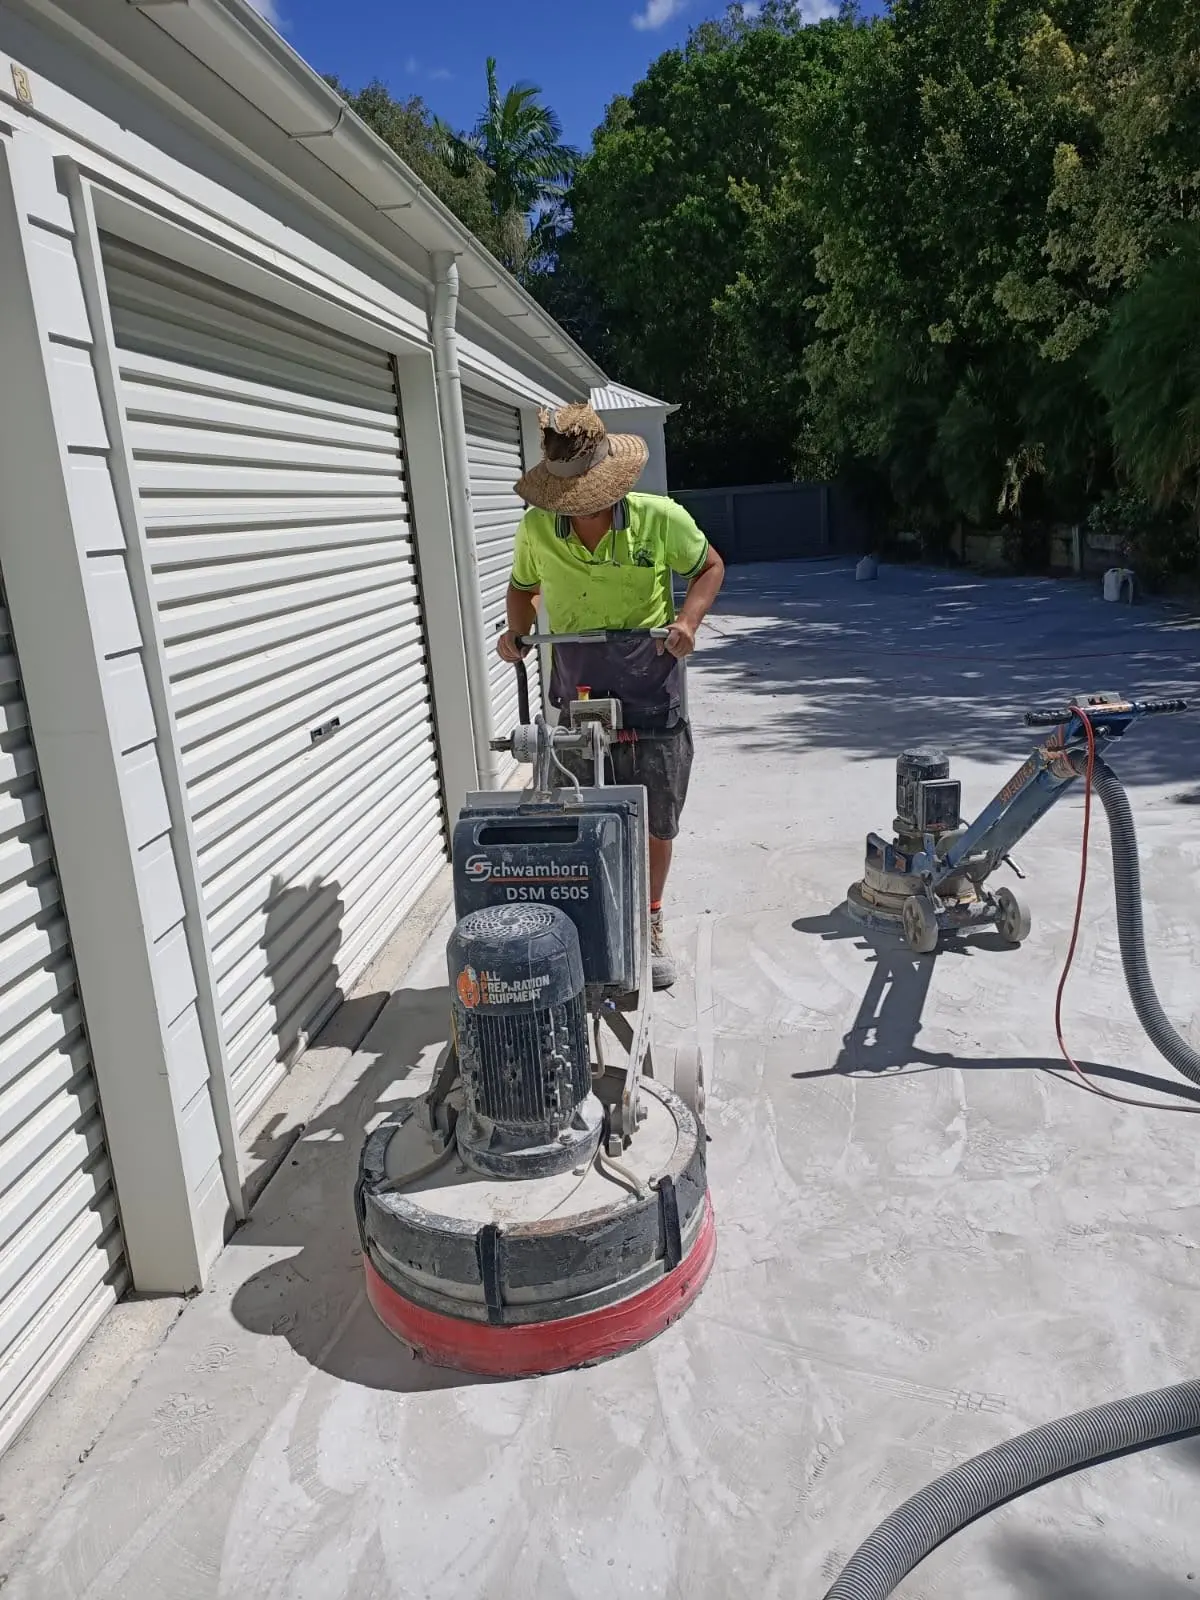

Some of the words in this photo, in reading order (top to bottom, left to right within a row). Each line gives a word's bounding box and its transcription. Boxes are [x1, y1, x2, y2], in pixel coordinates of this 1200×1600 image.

[465, 854, 589, 882] Schwamborn
[506, 887, 545, 900] DSM
[550, 886, 589, 900] 650S
[480, 970, 501, 981] ALL
[481, 988, 542, 1004] EQUIPMENT
